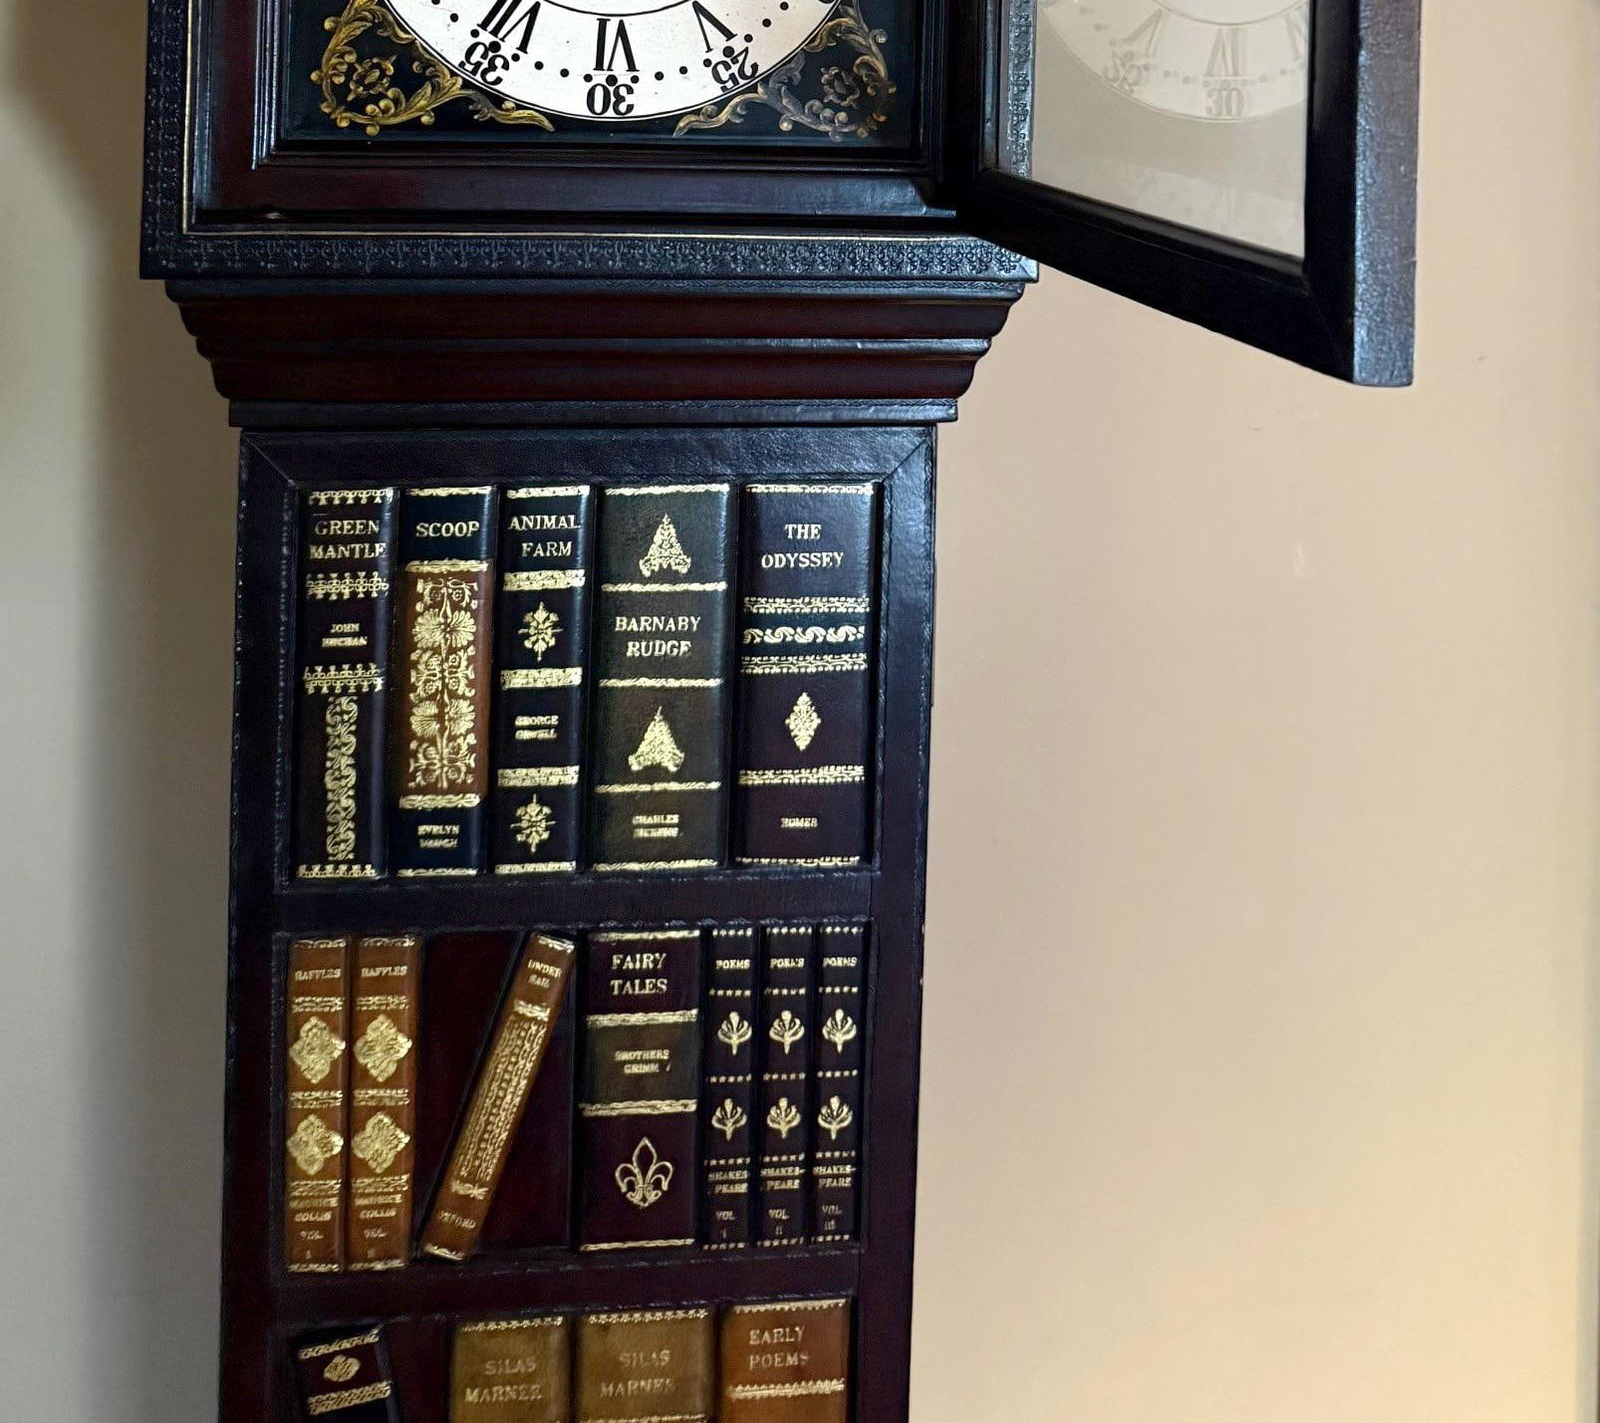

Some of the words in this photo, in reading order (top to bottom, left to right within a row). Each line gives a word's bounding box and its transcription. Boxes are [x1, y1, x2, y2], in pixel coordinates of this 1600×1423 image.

[691, 0, 738, 54] V
[593, 18, 640, 73] VI
[459, 41, 511, 87] 35
[711, 46, 759, 93] 25
[586, 83, 635, 117] 30
[315, 520, 380, 536] GREEN
[416, 521, 480, 537] SCOOP
[508, 514, 580, 531] ANIMAL
[784, 523, 822, 540] THE
[310, 543, 387, 559] MANTLE
[522, 541, 572, 557] FARM
[761, 552, 844, 569] ODYSSEY
[615, 615, 701, 632] BARNABY
[626, 640, 692, 658] RUDGE
[612, 953, 667, 971] FAIRY
[716, 959, 750, 970] POEMS
[823, 956, 857, 968] POEMS
[610, 979, 668, 996] TALES
[748, 1325, 806, 1345] EARLY
[484, 1359, 537, 1377] SILAS
[748, 1353, 809, 1370] POEMS
